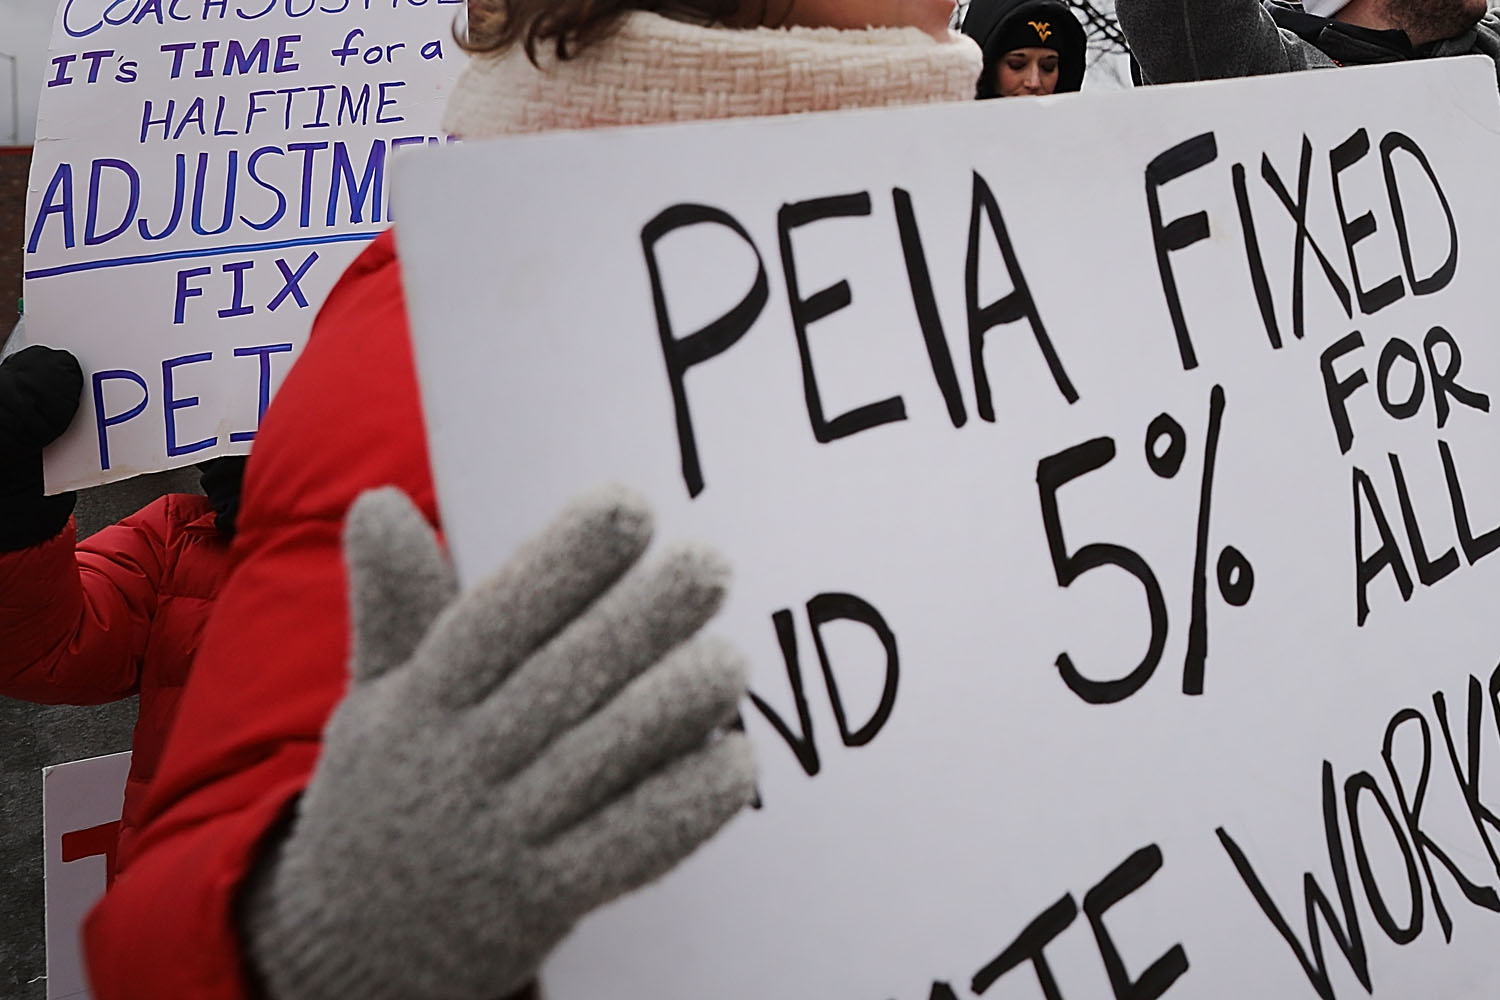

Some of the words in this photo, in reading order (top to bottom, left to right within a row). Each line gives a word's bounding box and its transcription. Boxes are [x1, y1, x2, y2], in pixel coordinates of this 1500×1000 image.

[139, 81, 406, 144] HALFTIME
[160, 34, 302, 80] TIME
[332, 28, 405, 67] for
[420, 38, 444, 62] a
[27, 135, 463, 254] ADJUSTM
[172, 251, 319, 325] FIX
[640, 168, 1080, 499] PEIA
[1145, 127, 1459, 371] FIXED
[92, 342, 293, 471] PEI
[1319, 325, 1491, 456] FOR
[733, 591, 900, 810] ND
[1036, 383, 1255, 705] 5%
